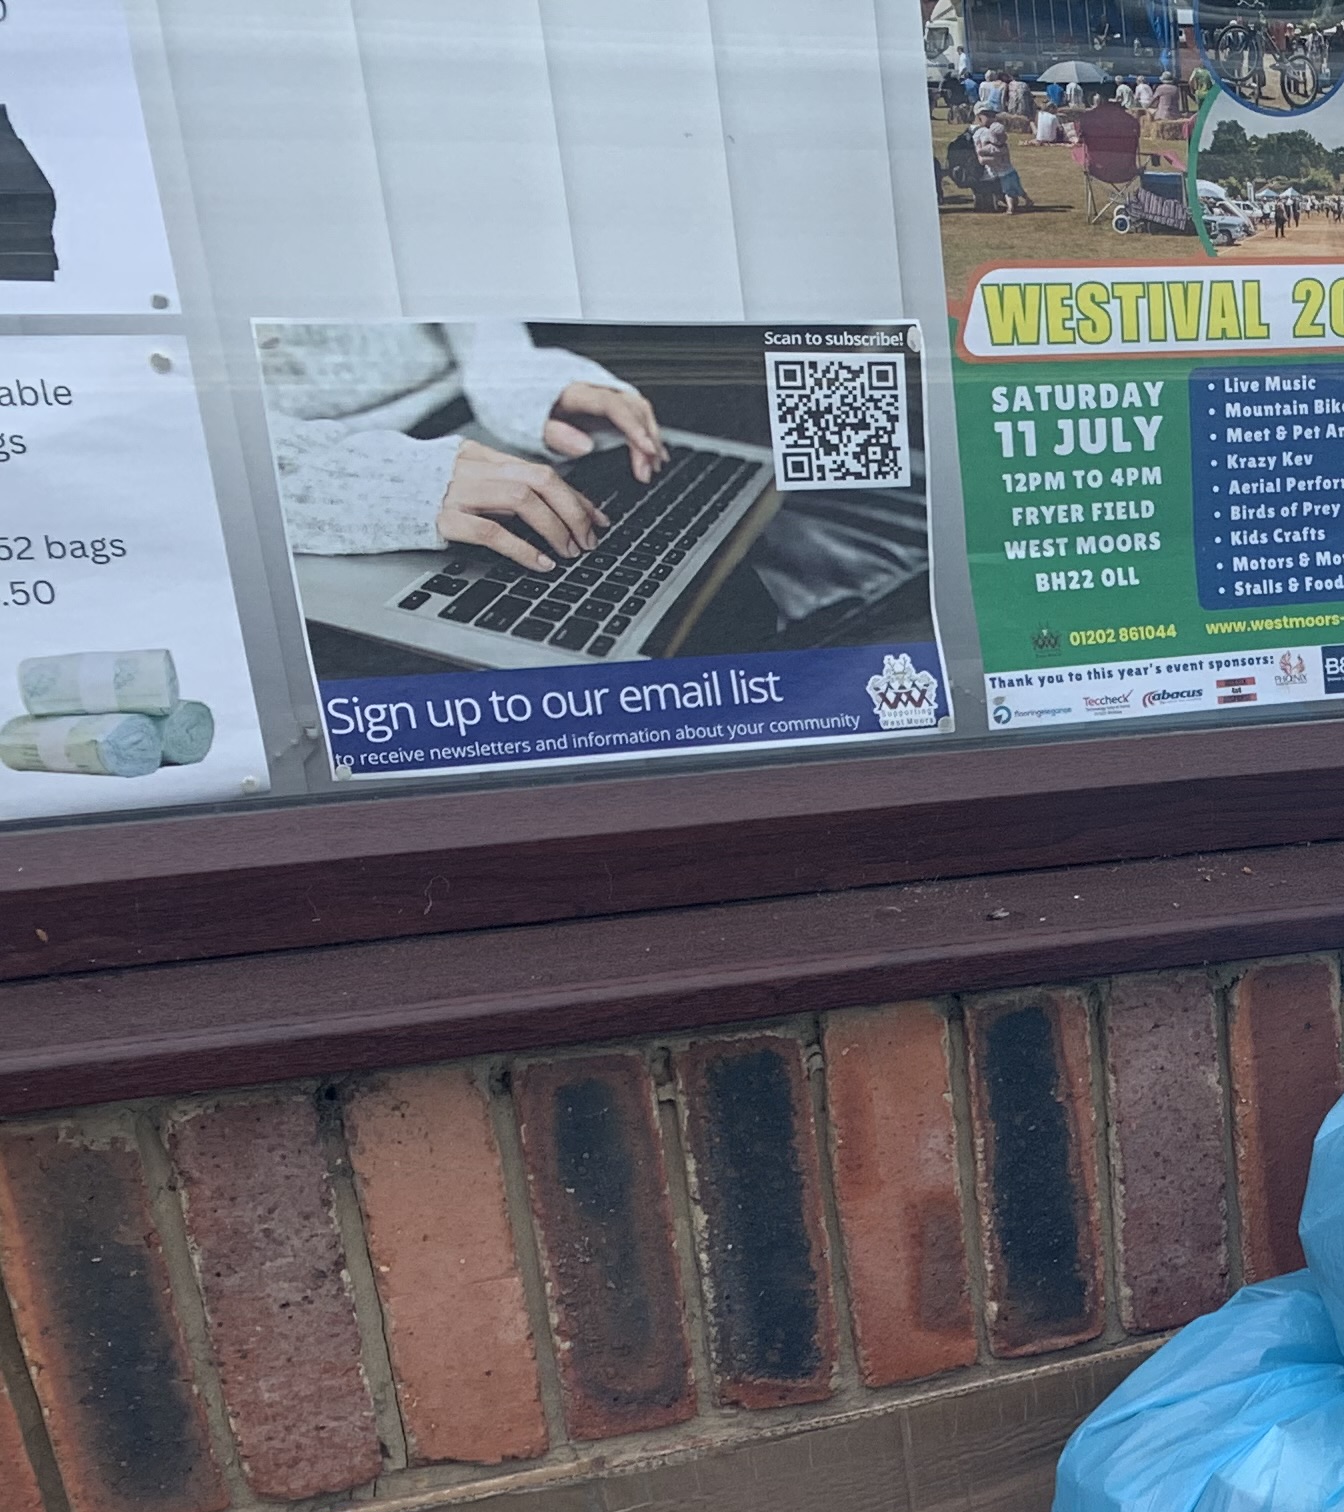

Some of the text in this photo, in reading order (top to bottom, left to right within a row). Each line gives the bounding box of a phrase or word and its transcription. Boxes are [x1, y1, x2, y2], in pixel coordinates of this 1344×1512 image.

[980, 279, 1270, 347] WESTIVAL
[764, 331, 903, 346] Scan to subscribe!
[1224, 375, 1316, 393] Live Music
[992, 381, 1165, 412] SATURDAY
[1225, 401, 1309, 418] Mountain
[994, 415, 1163, 457] 11 JULY
[1226, 427, 1271, 443] Meet
[1276, 426, 1288, 440] &
[1293, 425, 1320, 440] Pet
[1227, 452, 1313, 470] Krazy Kev
[1002, 467, 1162, 492] 12PM TO 4PM
[1229, 478, 1280, 495] Aerial
[1012, 500, 1155, 526] FRYER FIELD
[1230, 502, 1341, 520] Birds of Prey
[1004, 532, 1161, 559] WEST MOORS
[1230, 527, 1326, 545] Kids Crafts
[44, 535, 127, 565] bags
[1232, 555, 1294, 572] Motors
[1299, 553, 1310, 567] &
[1035, 570, 1094, 592] BH22
[1234, 579, 1283, 596] Stalls
[1288, 578, 1299, 592] &
[1305, 575, 1344, 591] Food
[1070, 624, 1177, 646] 01202 861044
[989, 655, 1274, 689] Thank you to this year's event sponsors:
[1151, 688, 1203, 701] abacus
[327, 670, 784, 743] Sign up to our email list
[335, 752, 354, 766] to
[360, 748, 425, 766] receive
[430, 739, 531, 760] newsletters
[535, 734, 568, 751] and
[572, 728, 670, 749] information
[675, 725, 725, 740] about
[727, 721, 765, 740] your
[769, 713, 860, 733] community
